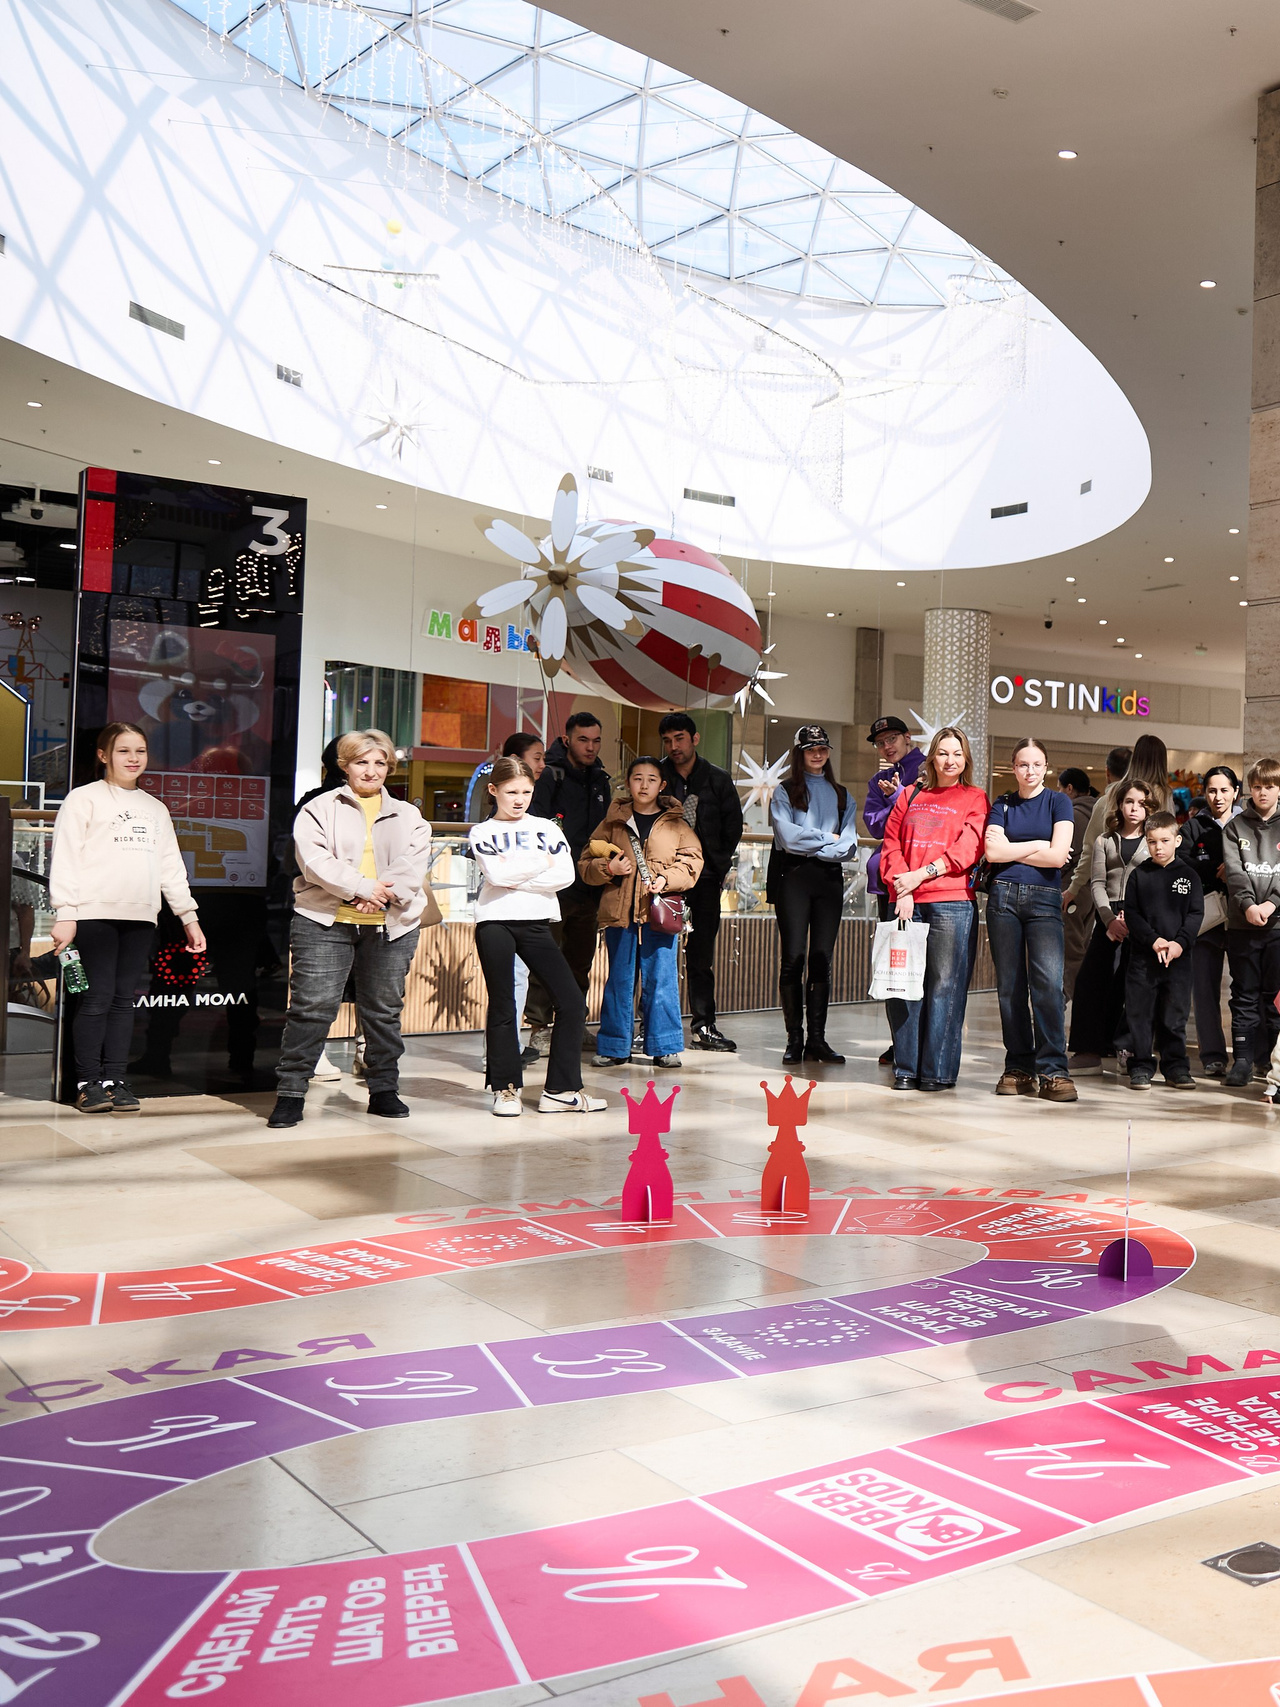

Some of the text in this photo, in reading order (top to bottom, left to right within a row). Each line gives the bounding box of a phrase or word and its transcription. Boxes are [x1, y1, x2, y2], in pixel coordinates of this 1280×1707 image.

[248, 506, 290, 555] 3
[132, 992, 249, 1008] ЛИНА МОЛЛ
[976, 1206, 1056, 1230] СДЕЛАЙ
[984, 1209, 1094, 1236] ДВА ШАГА
[1011, 1217, 1114, 1237] ВПЕРЕД
[989, 1267, 1091, 1291] 36
[869, 1305, 958, 1336] НАЗАД
[897, 1299, 988, 1329] ШАГОВ
[937, 1298, 1000, 1320] ПЯТЬ
[948, 1289, 1053, 1320] СДЕЛАЙ
[702, 1326, 768, 1362] ЗАДАНИЕ
[0, 1333, 377, 1413] СКАЯ
[1136, 1401, 1260, 1452] СДЕЛАЙ
[795, 1482, 898, 1527] BEBA
[835, 1473, 941, 1515] KIDS
[330, 1576, 387, 1667] ШАГОВ
[403, 1562, 460, 1660] ВПЕРЕД
[165, 1584, 281, 1699] СДЕЛАЙ
[258, 1595, 328, 1664] ПЯТЬ
